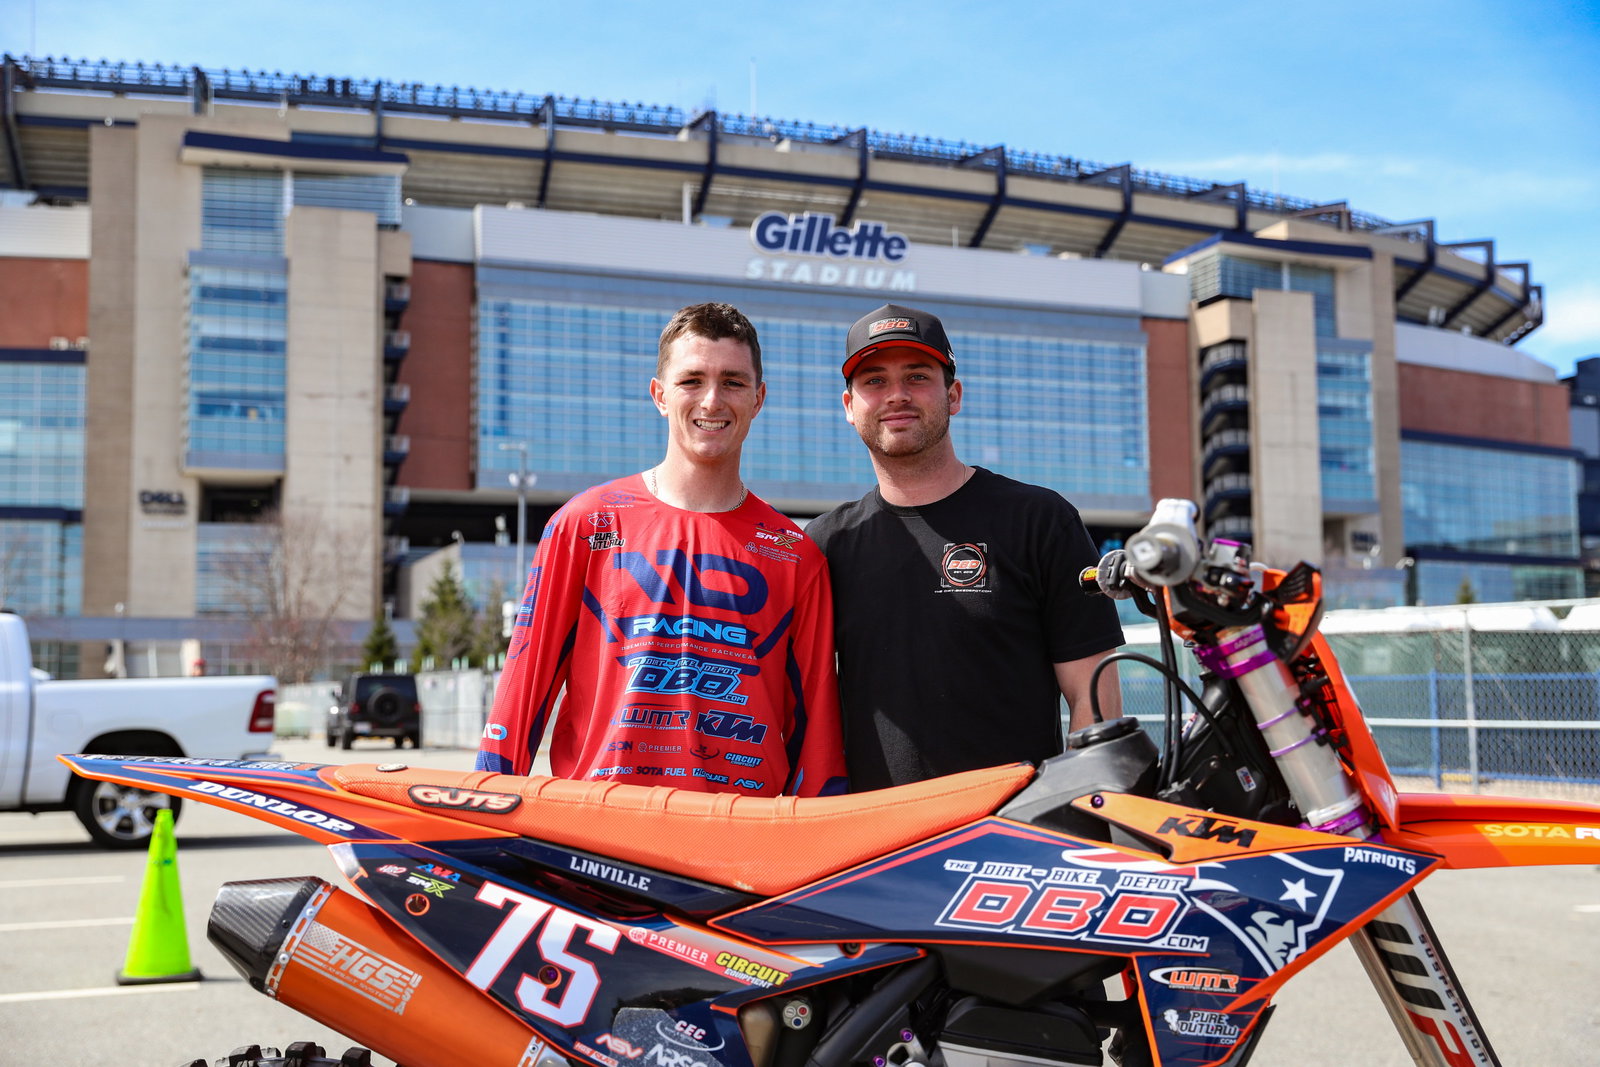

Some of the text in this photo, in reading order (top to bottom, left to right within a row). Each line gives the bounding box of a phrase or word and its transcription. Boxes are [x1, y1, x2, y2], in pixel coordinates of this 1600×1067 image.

[754, 213, 907, 262] Gillette
[746, 259, 917, 292] STADIUM
[948, 560, 981, 570] DBD
[633, 617, 746, 645] RACING
[629, 665, 738, 697] DBD
[703, 664, 737, 675] DEPOT
[620, 708, 768, 745] WMR KTM
[648, 744, 682, 752] PREMIER
[724, 752, 763, 766] CIRCUIT
[635, 766, 663, 776] SOTA
[664, 767, 687, 777] FUEL
[734, 778, 765, 790] ASV
[187, 780, 355, 834] DUNLOP
[411, 786, 517, 811] GUTS
[1156, 813, 1259, 848] KTM
[1483, 824, 1571, 839] SOTA
[415, 863, 461, 883] AMA
[569, 856, 652, 891] LINVILLE
[1343, 846, 1417, 876] PATRIOTS
[405, 872, 456, 899] SMX
[947, 861, 975, 873] THE
[1120, 874, 1186, 892] DEPOT
[946, 880, 1184, 941] DBD
[463, 880, 622, 1029] 75
[649, 933, 709, 963] PREMIER
[1160, 935, 1206, 950] .COM
[329, 945, 401, 991] HGS
[715, 951, 789, 986] CIRCUIT
[723, 967, 774, 990] EQUIPMENT
[1169, 971, 1240, 989] WMR
[392, 972, 423, 1017] USA
[674, 1020, 707, 1041] CEC
[1178, 1020, 1239, 1038] OUTLAW
[1190, 1011, 1228, 1024] PURE
[595, 1032, 644, 1060] ASV
